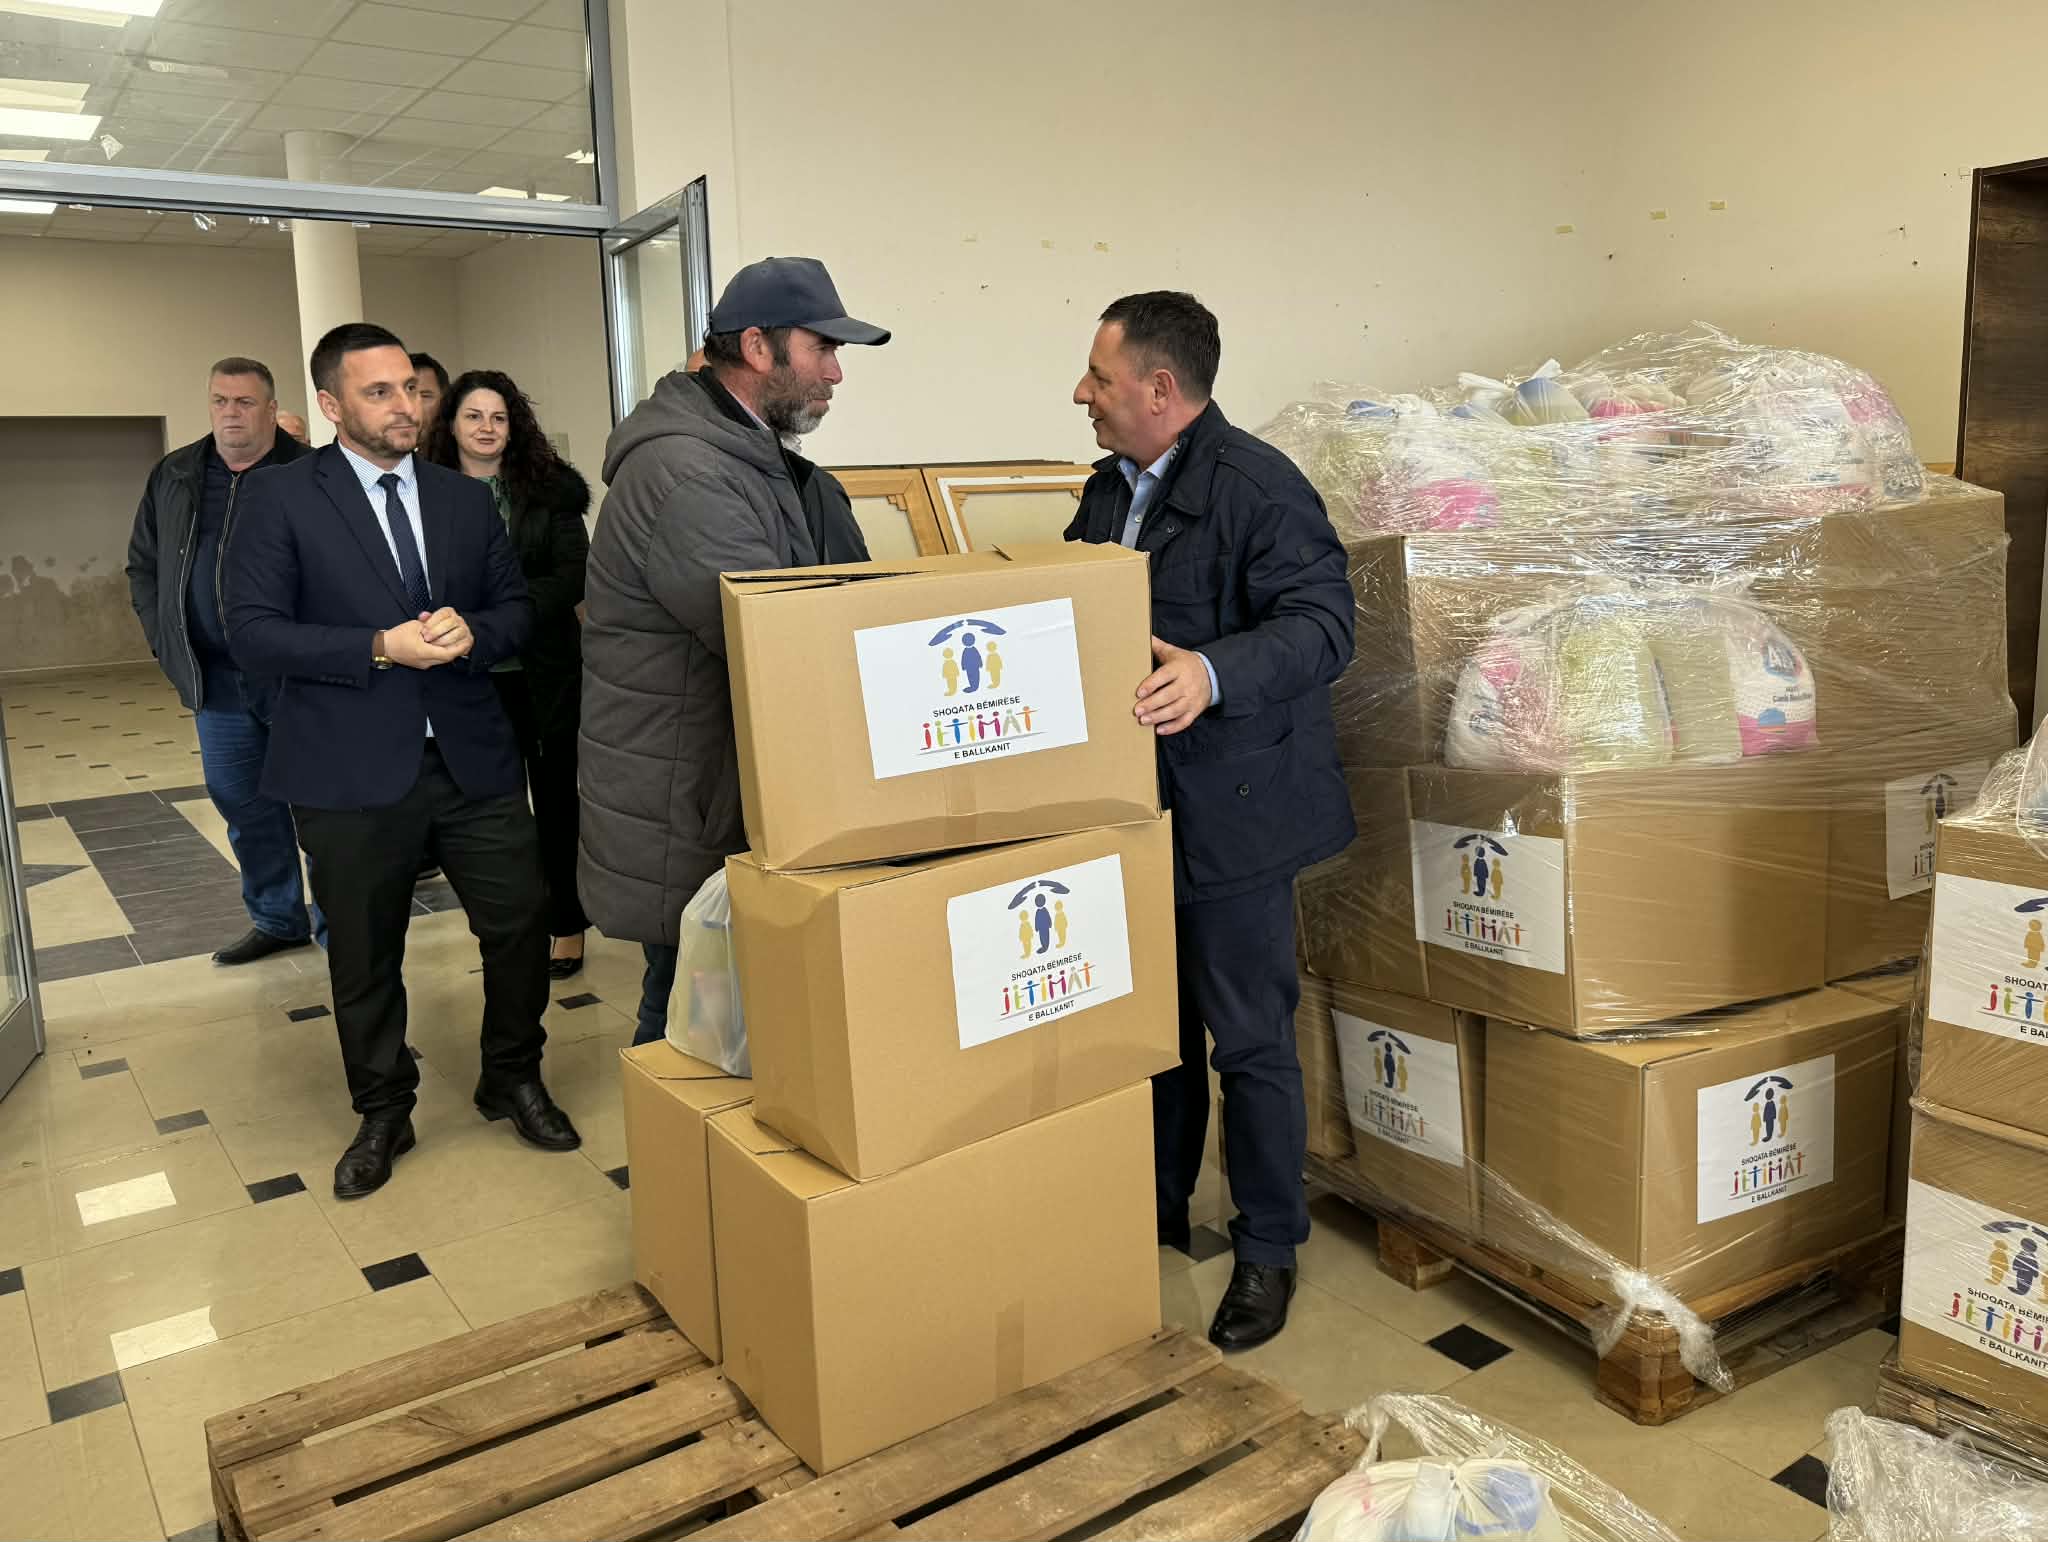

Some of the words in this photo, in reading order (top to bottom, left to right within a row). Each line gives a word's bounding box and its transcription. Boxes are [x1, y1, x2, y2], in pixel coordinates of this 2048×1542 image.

[933, 703, 975, 718] SHOQATA
[920, 706, 1038, 751] JETIMAT
[954, 751, 961, 759] E
[962, 742, 1012, 758] BALLKANIT
[1453, 900, 1481, 914] SHOQATA
[1445, 908, 1529, 947] JETIMAT
[1464, 941, 1470, 949] E
[1469, 942, 1505, 956] BALLKANIT
[1011, 965, 1047, 982] SHOQATA
[1000, 961, 1097, 1016] JETIMAT
[2004, 975, 2048, 992] SHOQAT
[1028, 1013, 1034, 1022] E
[1035, 1000, 1076, 1020] BALLKANIT
[2020, 1025, 2027, 1034] E
[1741, 1152, 1769, 1166] SHOQATA
[1729, 1151, 1807, 1197] JETIMAT
[1751, 1195, 1756, 1203] E
[1756, 1185, 1788, 1202] BALLKANIT
[1967, 1287, 2017, 1312] SHOQATA
[1979, 1336, 1987, 1346] E
